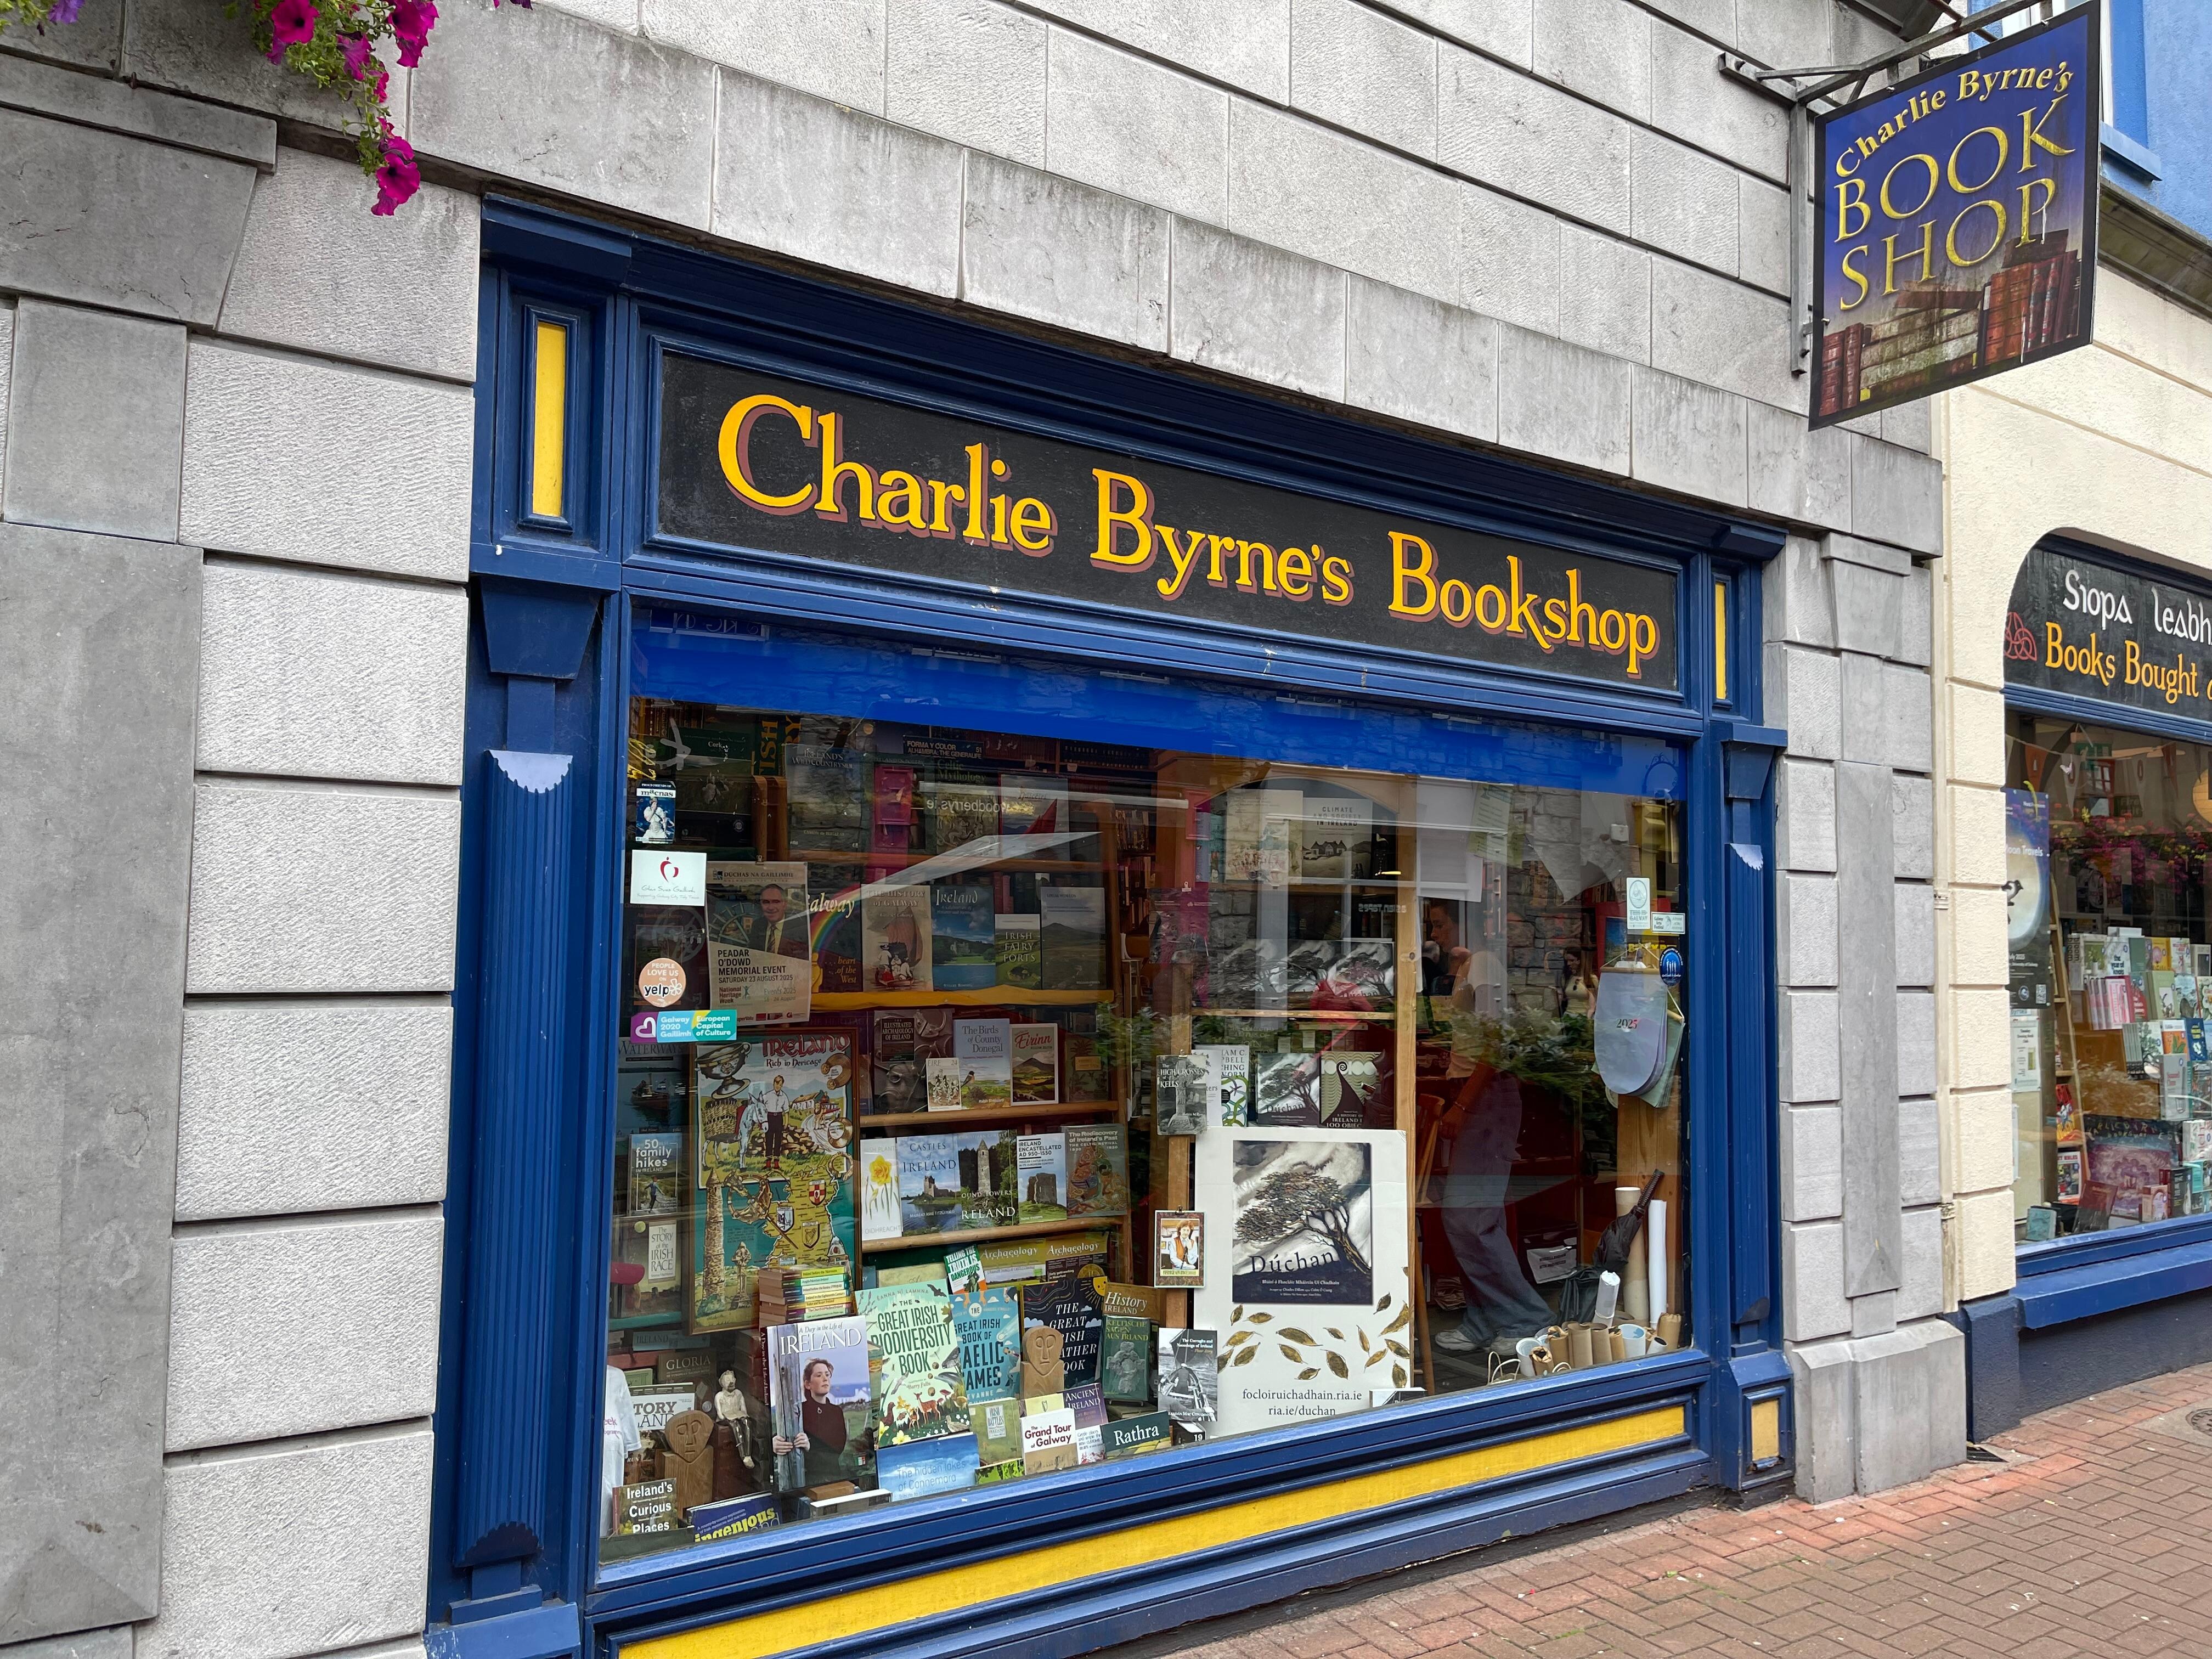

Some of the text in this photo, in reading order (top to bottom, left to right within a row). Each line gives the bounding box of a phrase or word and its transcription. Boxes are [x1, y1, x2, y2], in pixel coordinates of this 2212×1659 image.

[1836, 61, 2073, 178] Charlie Byrne's
[1834, 94, 2075, 243] BOOK
[1839, 178, 2056, 311] SHOP
[718, 394, 1660, 679] Charlie Byrne's Bookshop
[2063, 569, 2212, 645] Siopa leabh
[2045, 621, 2199, 704] Books Bought
[938, 770, 986, 783] Mythology
[936, 889, 978, 905] Ireland
[808, 893, 855, 918] alway
[718, 949, 749, 957] PEADAR
[1005, 943, 1034, 951] FAIRY
[718, 958, 751, 966] O'DOWD
[719, 966, 786, 975] MEMORIAL EVENT
[644, 984, 669, 997] yelp
[962, 1025, 999, 1035] The Birds
[1616, 1018, 1638, 1029] 2025
[763, 1034, 850, 1057] IRELAND
[975, 1035, 1001, 1044] County
[972, 1044, 1003, 1053] Donegal
[766, 1058, 782, 1068] Rich
[1267, 1103, 1304, 1113] Dúchan
[645, 1139, 658, 1149] 50
[910, 1142, 946, 1152] CASTLES
[636, 1147, 672, 1158] family
[636, 1157, 667, 1167] hikes
[903, 1159, 956, 1173] IRELAND
[962, 1207, 1015, 1220] RELAND
[651, 1233, 673, 1243] STORY
[651, 1248, 673, 1260] IRISH
[946, 1245, 975, 1263] TELLING THE
[981, 1247, 1038, 1260] Archaeology
[1047, 1242, 1099, 1256] Archaeology
[651, 1260, 673, 1271] RACE
[948, 1254, 978, 1272] TRUTH IS
[1249, 1252, 1334, 1272] Dúchan
[951, 1263, 980, 1281] DANGEROUS
[1056, 1302, 1079, 1314] THE
[1105, 1292, 1148, 1311] History
[1105, 1305, 1137, 1314] IRELAND
[878, 1305, 939, 1332] GREAT IRISH
[1049, 1316, 1086, 1329] GREAT
[954, 1319, 1001, 1334] GREAT IRISH
[636, 1334, 668, 1344] IRELAND
[781, 1328, 862, 1356] IRELAND
[871, 1324, 951, 1356] BIODIVERSITY
[962, 1331, 992, 1344] BOOK OF
[960, 1341, 1004, 1369] AELIC
[667, 1355, 711, 1370] GLORIA
[899, 1351, 931, 1376] BOOK
[963, 1366, 1001, 1390] AMES
[1065, 1387, 1099, 1402] ANCIENT
[1243, 1389, 1362, 1401] focloiruichadhain.ria.ie
[1068, 1398, 1100, 1410] IRELAND
[1268, 1405, 1336, 1416] ria.ie/duchan
[990, 1407, 1000, 1416] IRISH
[988, 1416, 1004, 1426] BATTLES
[1025, 1424, 1071, 1439] Grand Tour
[1113, 1424, 1160, 1446] Rathra
[1036, 1435, 1071, 1447] Galway
[898, 1460, 966, 1479] The hidden lakes
[899, 1474, 956, 1492] of Connemara
[627, 1482, 673, 1500] Ireland's
[629, 1502, 672, 1517] Curious
[633, 1521, 670, 1534] Places
